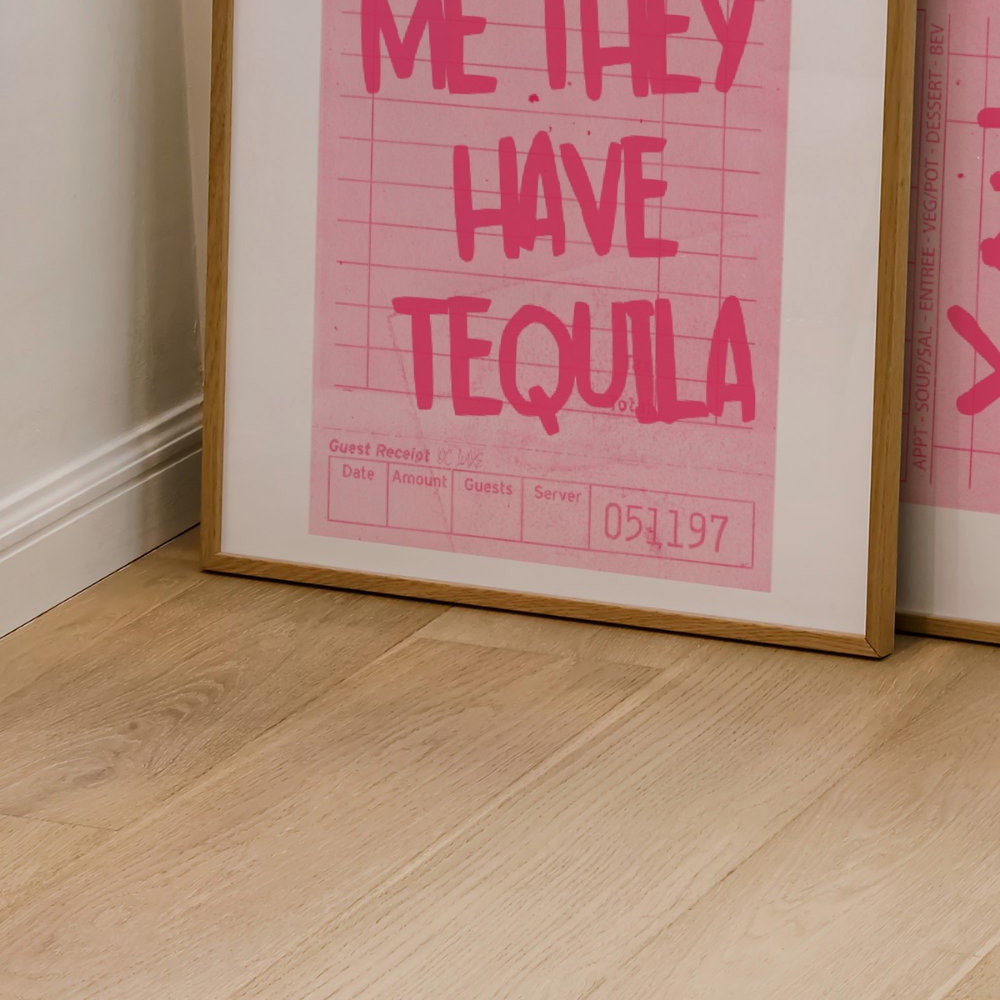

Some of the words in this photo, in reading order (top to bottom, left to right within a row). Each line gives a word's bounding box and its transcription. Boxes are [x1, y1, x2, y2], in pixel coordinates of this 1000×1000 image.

[929, 23, 945, 56] BEV
[926, 70, 942, 143] DESSERT
[453, 131, 678, 261] HAVE
[922, 157, 939, 233] VEG/POT
[919, 247, 936, 311] ENTREE
[392, 295, 756, 435] TEQUILA
[913, 327, 933, 412] SOUP/SAL
[329, 438, 370, 458] Guest
[376, 442, 430, 463] Receipt
[911, 425, 928, 471] APPT
[342, 464, 374, 482] Date
[392, 469, 447, 490] Amount
[464, 478, 513, 496] Guests
[534, 485, 582, 504] Server
[604, 502, 729, 553] 051197
